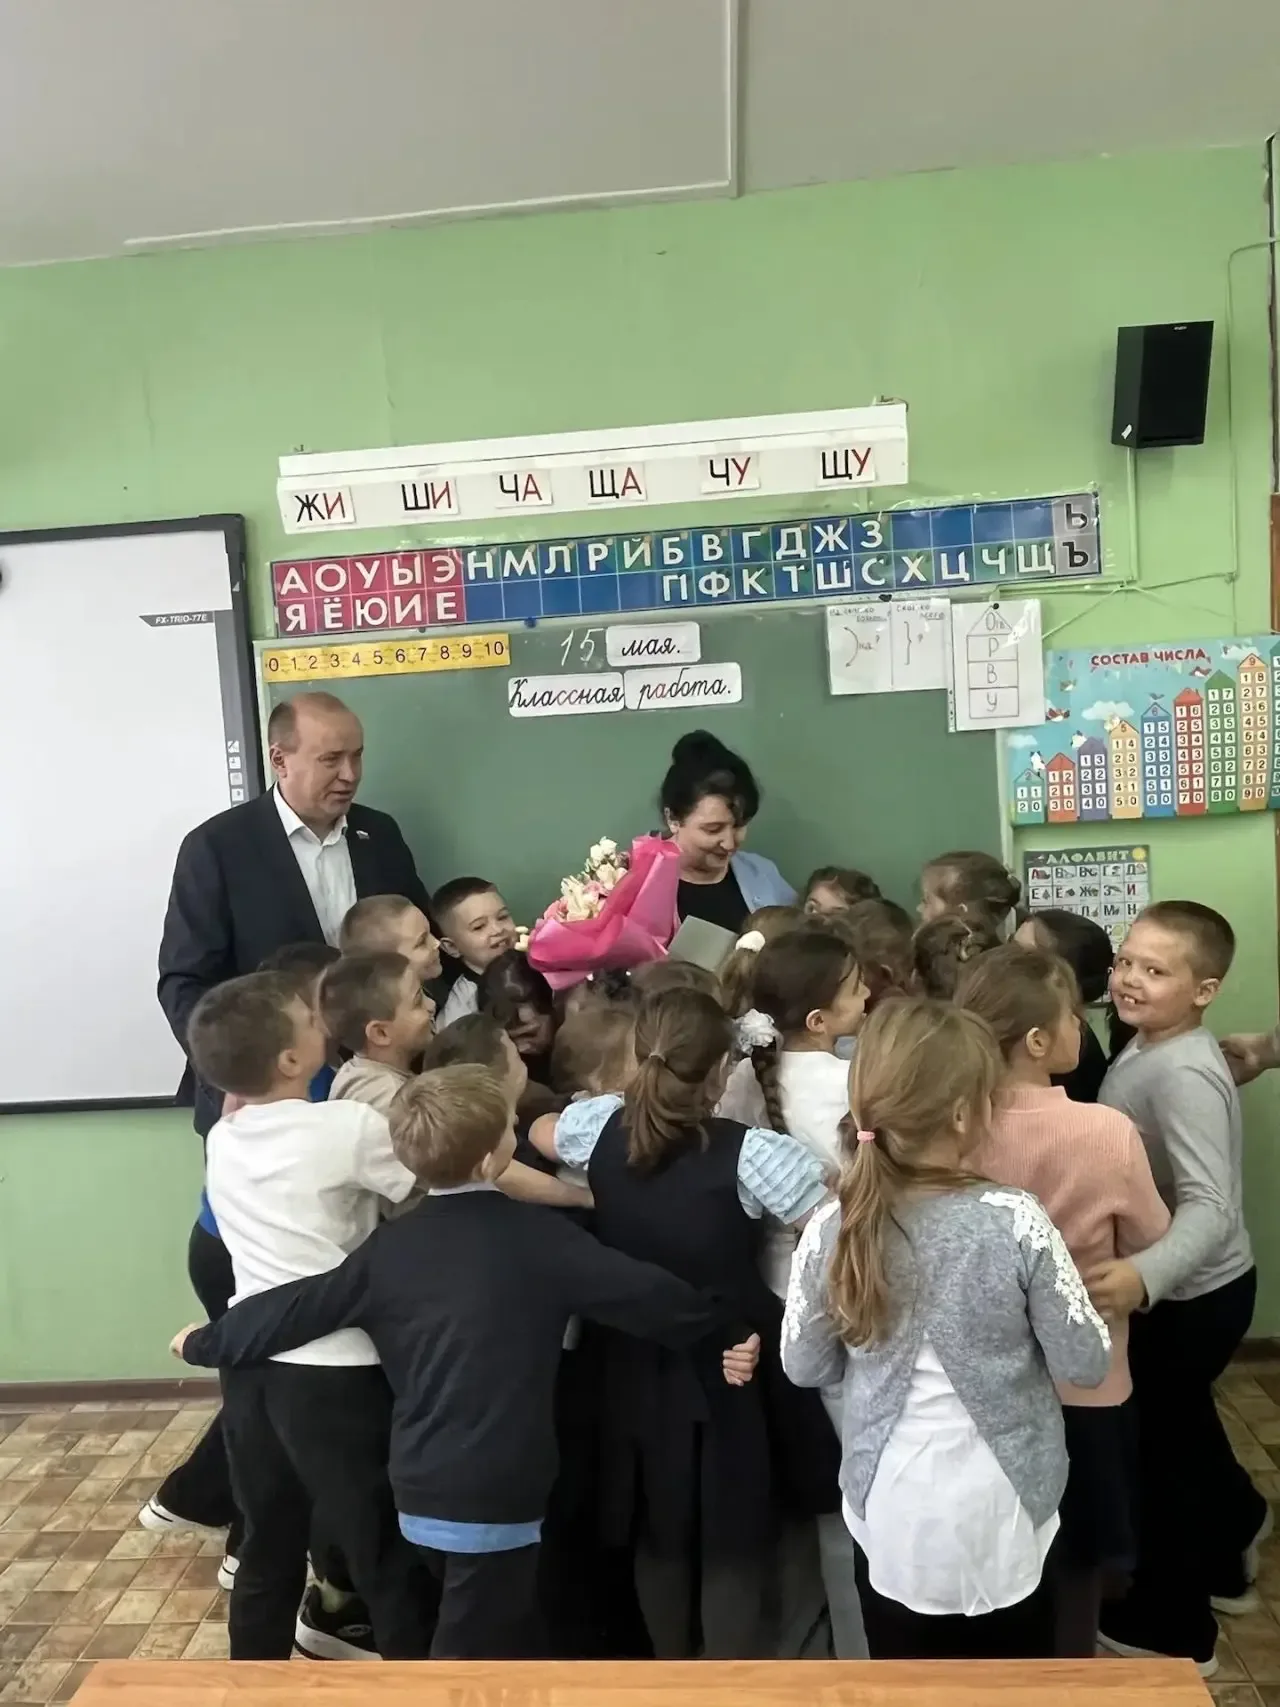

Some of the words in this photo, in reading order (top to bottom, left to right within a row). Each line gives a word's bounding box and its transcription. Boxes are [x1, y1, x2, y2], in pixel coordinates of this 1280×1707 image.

[821, 447, 871, 480] ЩУ
[709, 456, 751, 486] ЧУ
[499, 474, 543, 501] ЧА
[589, 467, 642, 499] ЩА
[401, 481, 452, 511] ШИ
[293, 492, 346, 522] ЖИ
[280, 567, 308, 594] А
[315, 563, 346, 593] О
[354, 560, 380, 589] У
[392, 557, 422, 586] Ы
[432, 554, 455, 583] Э
[468, 551, 494, 580] Н
[503, 549, 537, 577] М
[544, 545, 572, 574] Л
[588, 544, 608, 571] Р
[624, 537, 652, 568] Й
[662, 537, 684, 565] Б
[702, 534, 724, 561] В
[742, 531, 762, 558] Г
[775, 526, 808, 560] Д
[812, 524, 849, 553] Ж
[859, 520, 883, 549] З
[285, 604, 306, 632] Я
[323, 596, 345, 629] Ё
[356, 597, 387, 626] Ю
[394, 595, 422, 623] И
[436, 591, 458, 620] Е
[662, 574, 688, 602] П
[698, 570, 730, 598] Ф
[743, 567, 768, 596] К
[781, 564, 806, 593] Т
[816, 561, 850, 590] Ш
[861, 558, 886, 587] С
[900, 556, 927, 584] Х
[940, 551, 970, 582] Ц
[981, 548, 1006, 575] Ч
[1016, 544, 1056, 574] Щ
[1062, 541, 1088, 568] Ъ
[560, 628, 604, 667] 15
[621, 634, 680, 657] мая.
[268, 657, 280, 672] 0
[291, 656, 297, 671] 1
[308, 655, 318, 670] 2
[330, 654, 340, 668] 3
[351, 652, 361, 666] 4
[373, 650, 383, 665] 5
[394, 648, 406, 664] 6
[417, 647, 427, 661] 7
[440, 645, 450, 660] 8
[461, 644, 472, 658] 9
[484, 641, 504, 656] 10
[1091, 652, 1149, 666] СОСТАВ
[1154, 648, 1206, 662] ЧИСЛА
[510, 678, 624, 708] Классная
[637, 666, 732, 710] работа.
[1243, 688, 1250, 697] 2
[1258, 687, 1264, 696] 7
[1225, 690, 1231, 698] 7
[1192, 707, 1199, 715] 6
[1211, 705, 1218, 714] 2
[1244, 702, 1251, 712] 3
[1258, 702, 1265, 711] 6
[1179, 722, 1185, 731] 2
[1193, 721, 1200, 730] 5
[1212, 719, 1219, 728] 3
[1226, 718, 1233, 727] 5
[1245, 718, 1251, 726] 4
[1259, 716, 1266, 725] 5
[1160, 723, 1167, 731] 5
[1213, 734, 1219, 742] 4
[1227, 733, 1233, 741] 4
[1259, 731, 1266, 739] 4
[1128, 739, 1134, 747] 4
[1147, 738, 1153, 747] 2
[1161, 737, 1167, 745] 4
[1180, 736, 1186, 745] 3
[1180, 751, 1186, 759] 4
[1195, 750, 1201, 759] 3
[1213, 748, 1220, 757] 5
[1227, 747, 1234, 756] 3
[1245, 746, 1252, 755] 6
[1259, 745, 1266, 755] 3
[1097, 755, 1103, 764] 3
[1115, 755, 1121, 763] 2
[1128, 753, 1135, 763] 3
[1147, 752, 1154, 761] 3
[1161, 751, 1168, 761] 3
[1180, 764, 1187, 774] 5
[1195, 764, 1201, 773] 2
[1213, 763, 1220, 772] 6
[1227, 762, 1234, 771] 2
[1245, 761, 1252, 769] 7
[1259, 760, 1265, 769] 2
[1083, 771, 1090, 779] 2
[1097, 770, 1104, 779] 2
[1115, 769, 1122, 777] 3
[1129, 768, 1136, 777] 2
[1148, 767, 1154, 775] 4
[1162, 766, 1169, 775] 2
[1064, 773, 1071, 782] 2
[1214, 778, 1219, 787] 7
[1084, 785, 1090, 794] 3
[1116, 783, 1122, 791] 4
[1148, 781, 1155, 790] 5
[1051, 787, 1058, 796] 2
[1227, 790, 1234, 799] 0
[1244, 789, 1251, 798] 9
[1257, 788, 1264, 797] 0
[1116, 797, 1123, 806] 5
[1130, 796, 1137, 805] 0
[1148, 795, 1155, 805] 6
[1162, 794, 1170, 804] 0
[1182, 794, 1188, 802] 7
[1195, 793, 1202, 802] 0
[1020, 802, 1026, 812] 2
[1033, 802, 1040, 811] 0
[1052, 801, 1058, 810] 3
[1066, 800, 1073, 809] 0
[1084, 799, 1090, 808] 4
[1098, 798, 1105, 807] 0
